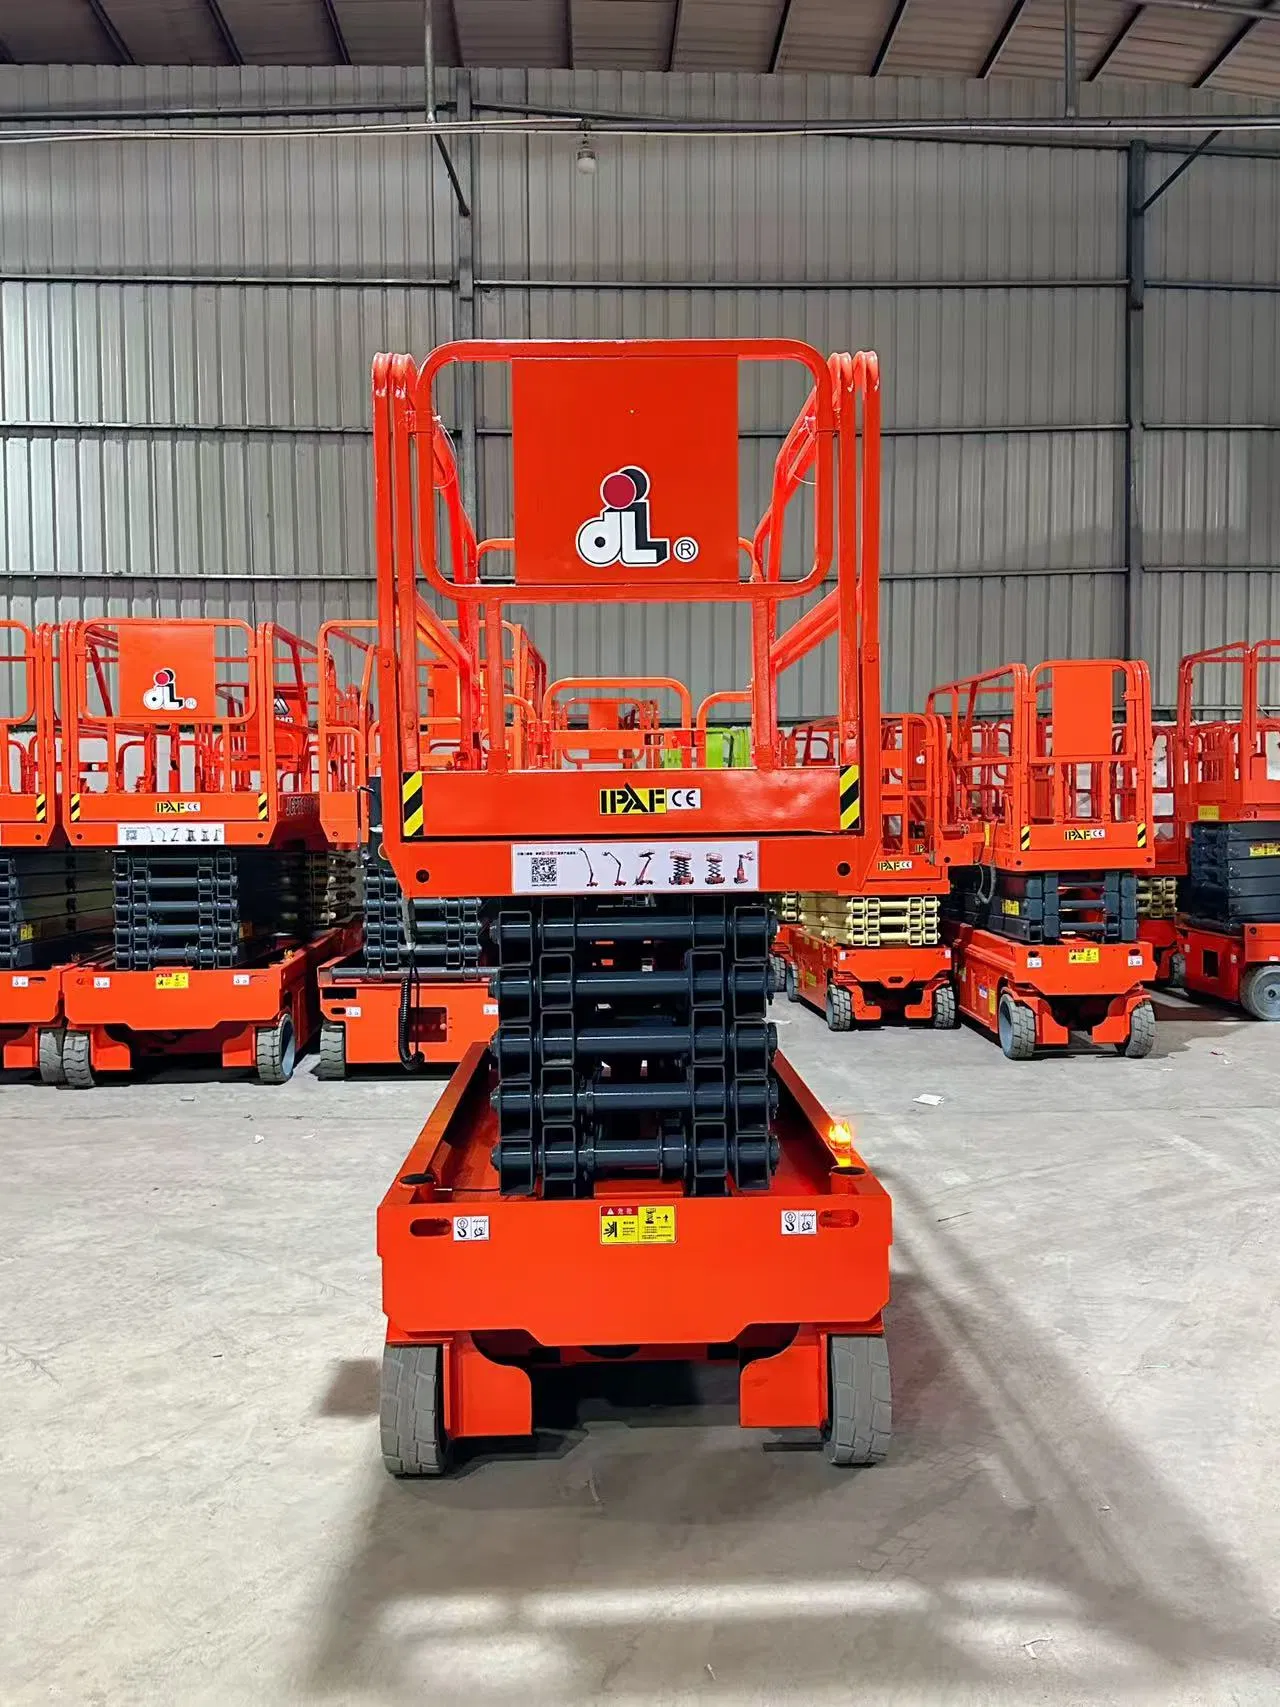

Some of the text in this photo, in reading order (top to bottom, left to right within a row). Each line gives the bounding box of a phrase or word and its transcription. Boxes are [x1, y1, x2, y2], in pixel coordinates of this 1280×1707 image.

[601, 782, 696, 814] IPAF CE
[157, 800, 198, 812] IPAF CE
[1065, 828, 1091, 840] IPAF
[878, 860, 900, 870] IPAF
